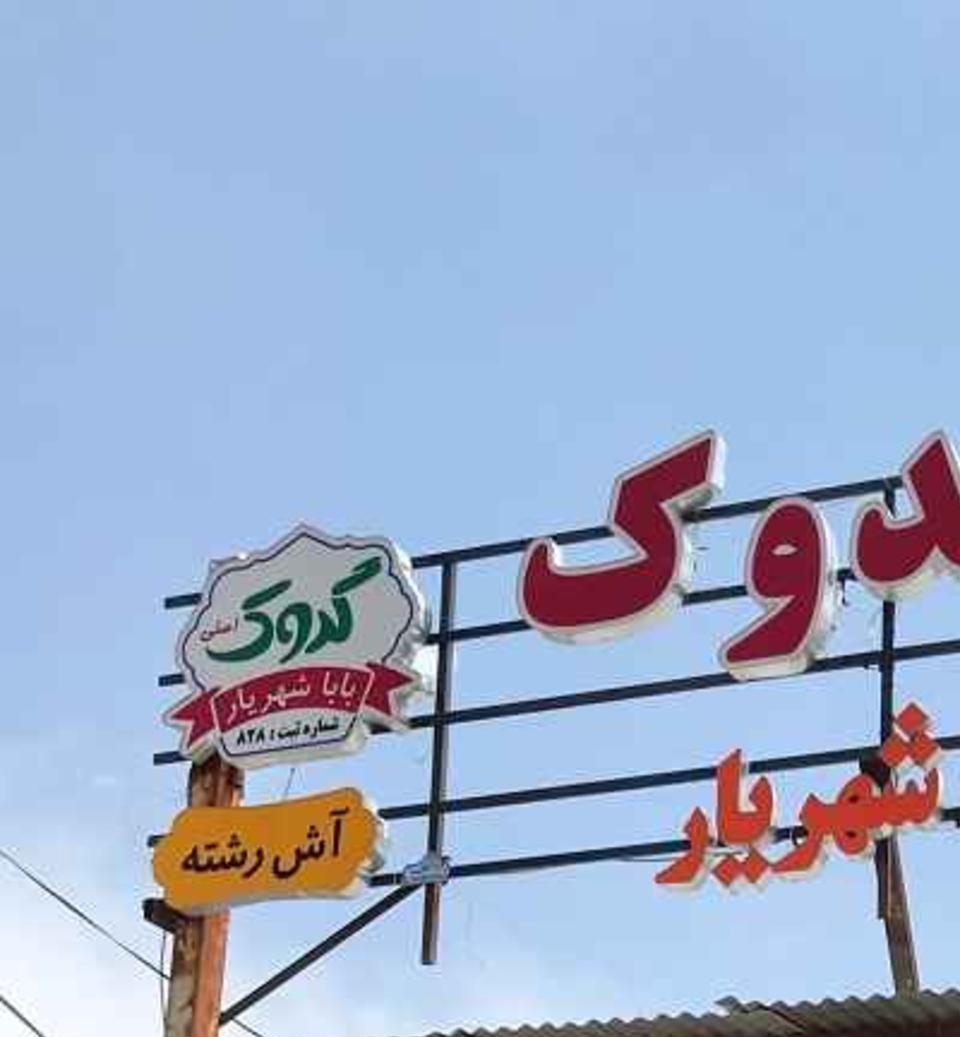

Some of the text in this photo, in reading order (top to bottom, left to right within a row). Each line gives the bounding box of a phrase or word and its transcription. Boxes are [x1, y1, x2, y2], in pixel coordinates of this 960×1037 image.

[206, 556, 382, 664] گدوک
[227, 671, 357, 724] بابا شهریار
[303, 716, 339, 739] شماره
[654, 701, 943, 893] شهریار
[180, 808, 350, 879] آش رشته
